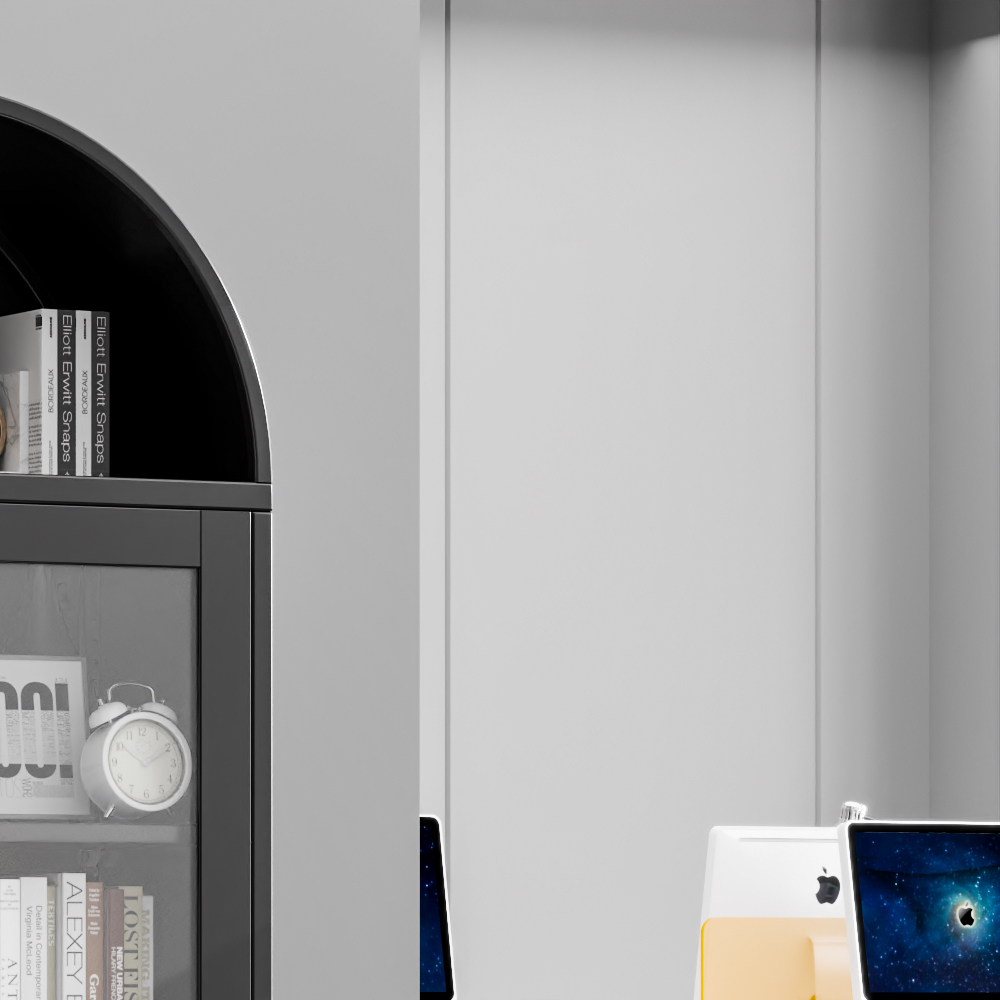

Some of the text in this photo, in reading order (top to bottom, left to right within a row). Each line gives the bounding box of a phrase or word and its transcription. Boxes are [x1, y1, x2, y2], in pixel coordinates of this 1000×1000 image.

[61, 315, 73, 462] Elliott Erwitt Snaps
[95, 316, 107, 464] Elliott Erwitt Snaps
[25, 906, 33, 976] Virginia McLeod
[35, 905, 43, 929] Detail
[66, 881, 83, 984] ALEXEY
[123, 896, 139, 960] LOST
[116, 946, 124, 971] NEW
